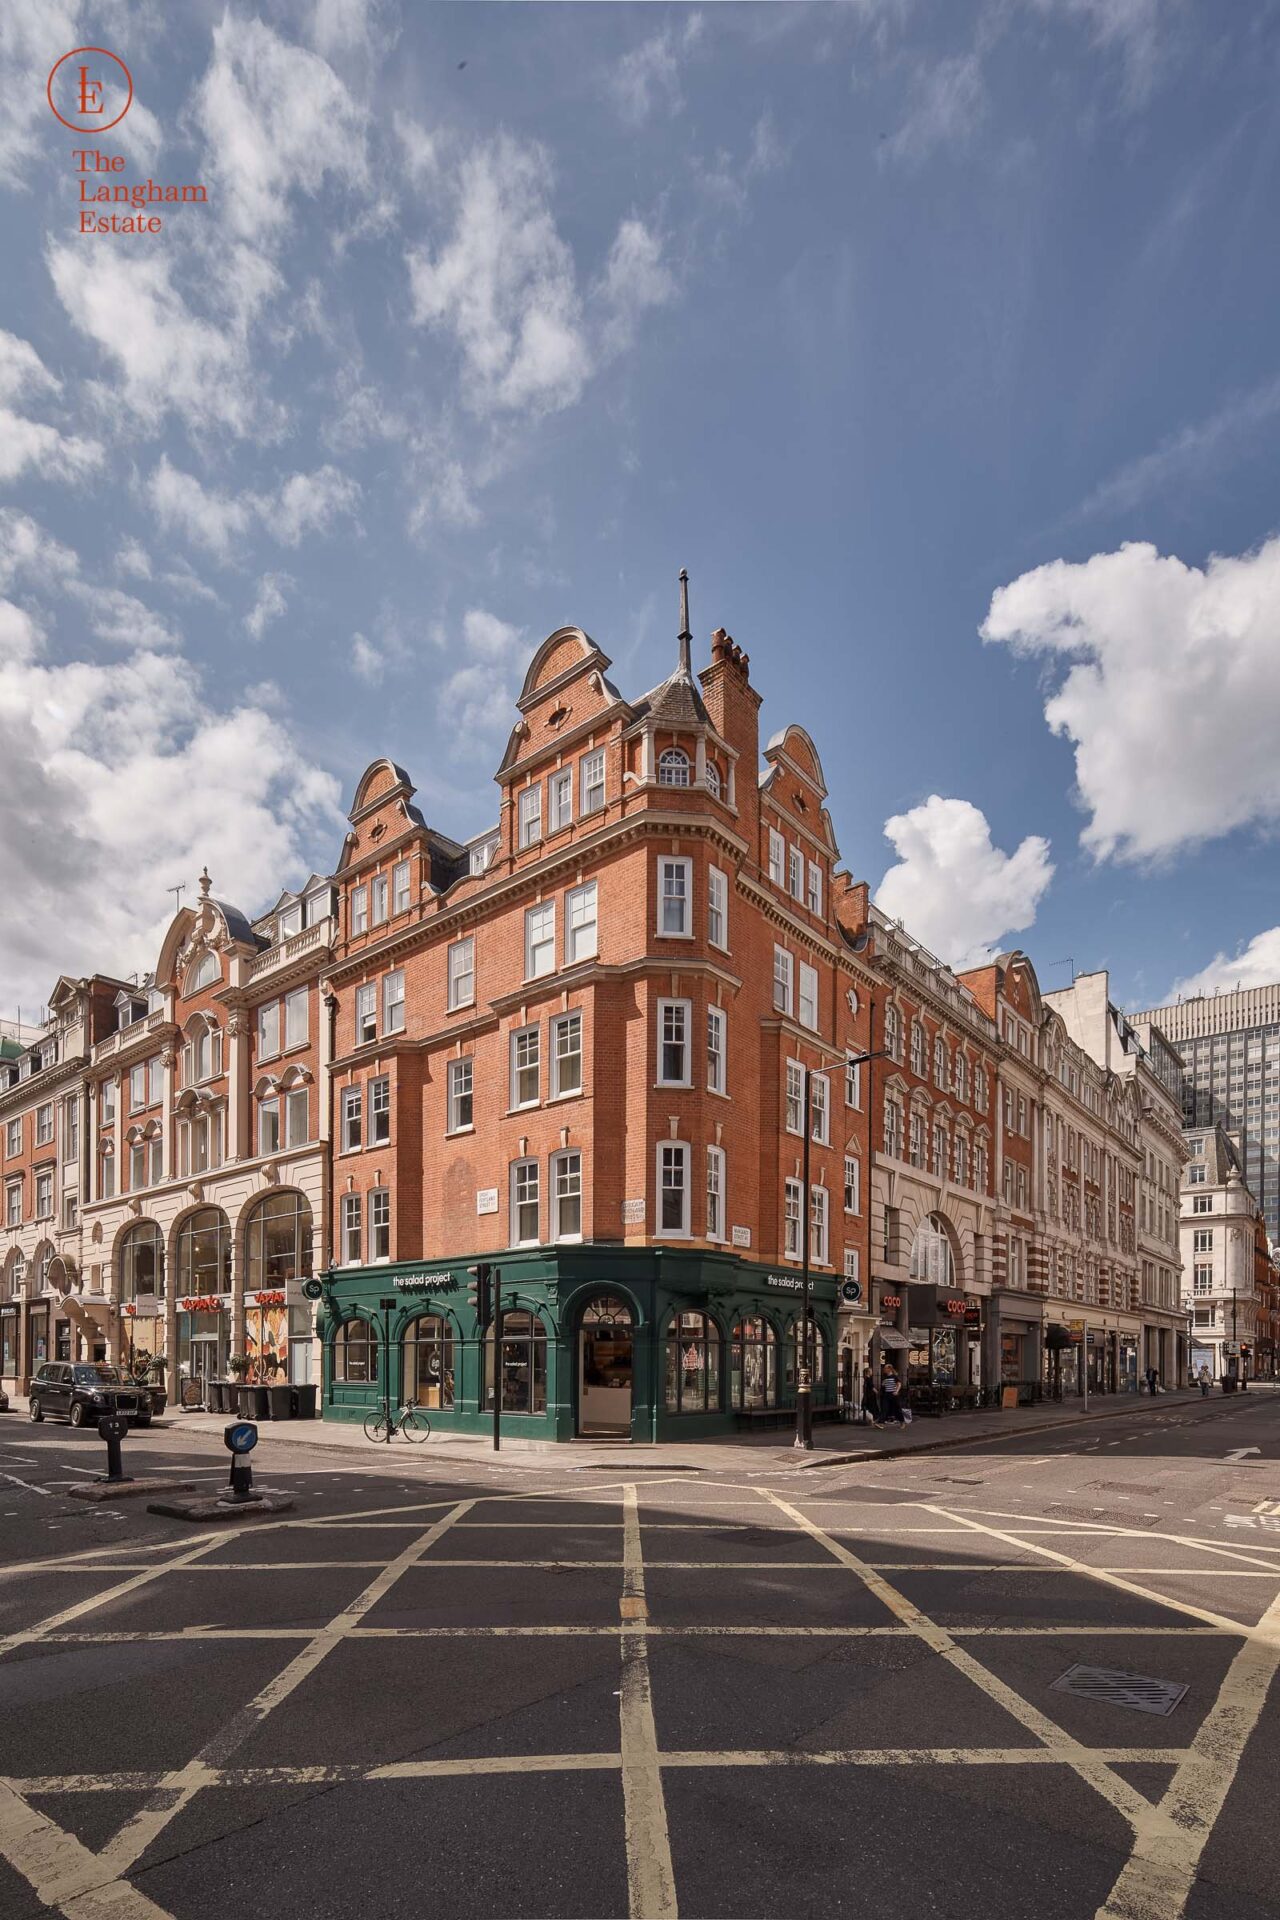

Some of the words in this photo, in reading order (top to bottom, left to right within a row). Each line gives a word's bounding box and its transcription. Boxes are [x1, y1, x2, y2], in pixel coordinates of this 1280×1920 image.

[393, 1276, 405, 1286] the
[405, 1274, 424, 1286] salad
[425, 1272, 451, 1286] project
[767, 1275, 778, 1285] the
[778, 1276, 794, 1288] salad
[884, 1296, 901, 1307] COCO
[947, 1300, 966, 1313] COCO
